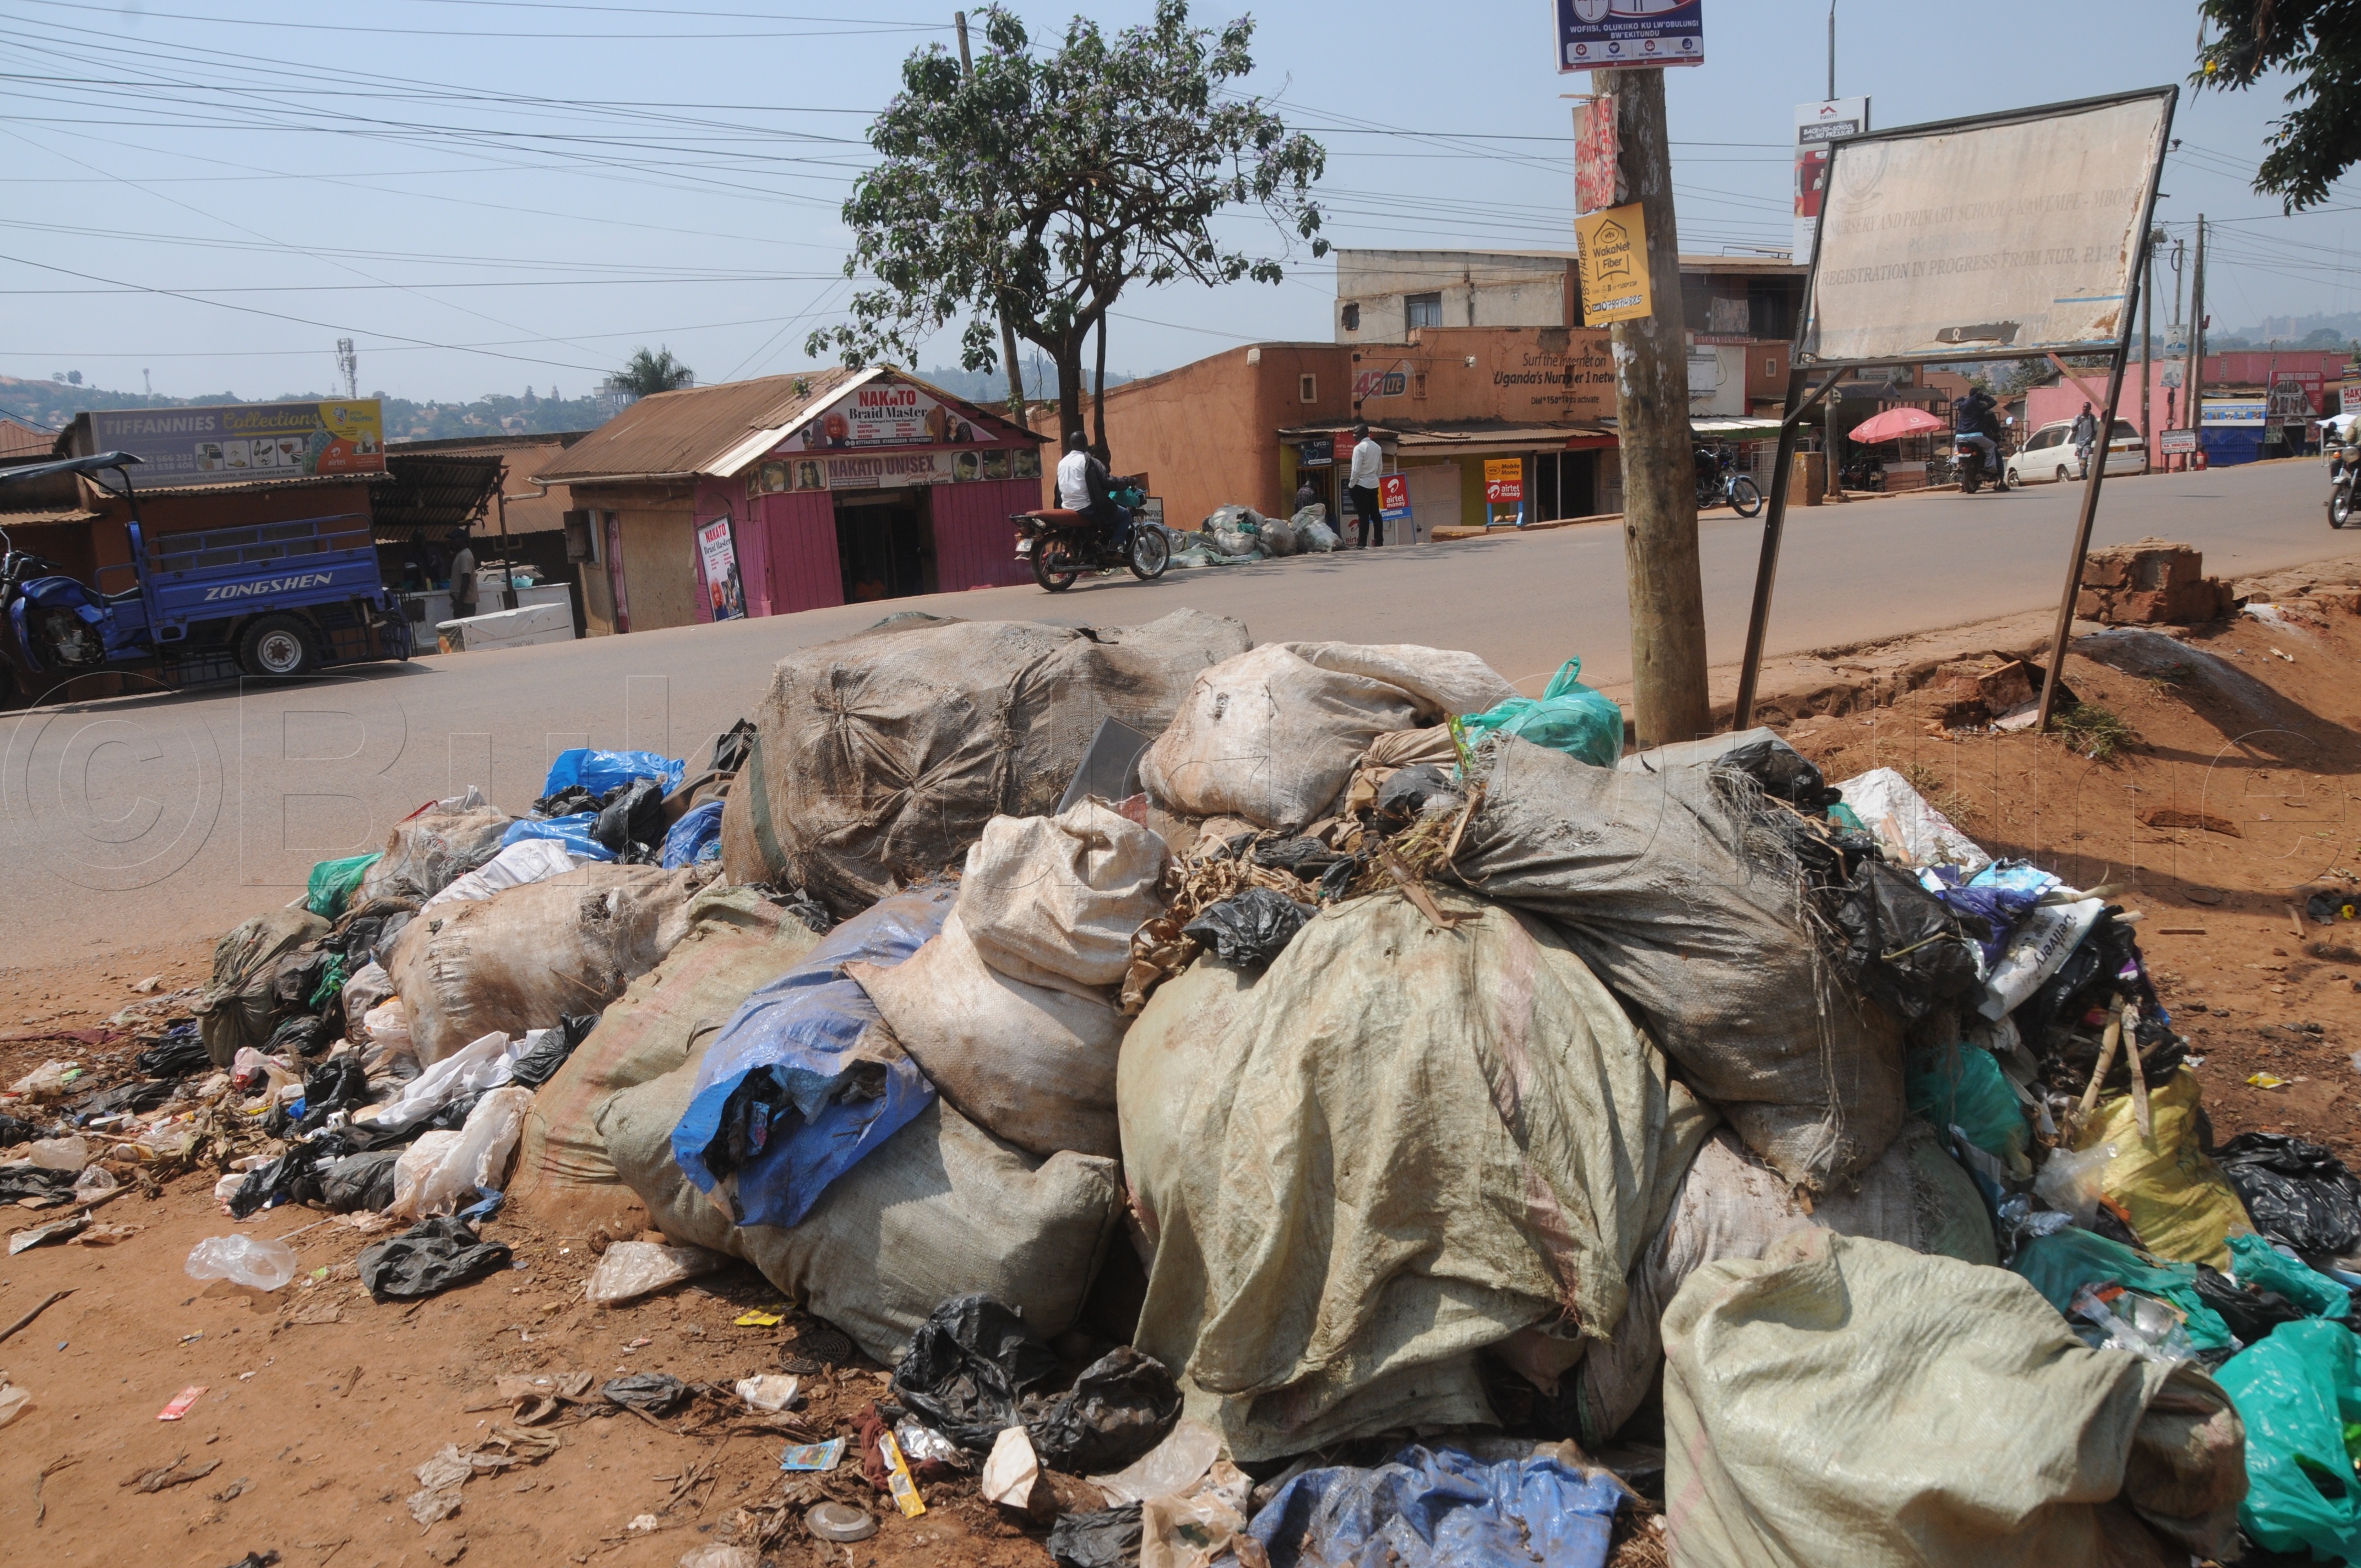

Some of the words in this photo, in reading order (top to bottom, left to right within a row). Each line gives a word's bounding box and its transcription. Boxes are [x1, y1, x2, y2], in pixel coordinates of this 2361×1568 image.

[1603, 23, 1639, 31] OLUKIIKO
[1653, 20, 1699, 28] LW'OBULUNGI
[1611, 30, 1660, 39] BW'EKITUNDU
[1828, 214, 1879, 238] NURSERY
[1877, 213, 1901, 231] AND
[1902, 206, 1955, 227] PRIMARY
[1957, 199, 2006, 222] SCHOOL
[2016, 192, 2082, 215] KAWEMPE
[1593, 240, 1630, 258] WakaNet
[1603, 257, 1623, 269] Fiber
[1820, 262, 1910, 287] REGISTRATION
[1912, 261, 1927, 277] IN
[1928, 254, 1998, 275] PROGRESS
[2001, 249, 2043, 269] FROM
[1522, 352, 1542, 367] Surf
[1543, 353, 1557, 367] the
[1595, 358, 1606, 367] on
[1385, 377, 1402, 393] LTE
[1493, 371, 1543, 388] Uganda's
[1585, 371, 1591, 384] 1
[1592, 371, 1615, 384] netw
[859, 390, 916, 407] NAKATO
[1577, 395, 1600, 404] activate
[849, 406, 883, 420] Braid
[885, 406, 928, 420] Master
[104, 416, 216, 435] TIFFANNIES
[222, 411, 322, 429] Collections
[176, 453, 193, 461] 232
[328, 458, 346, 466] airtel
[828, 458, 882, 477] NAKATO
[884, 455, 936, 475] UNISEX
[931, 469, 951, 480] Salon
[1501, 484, 1520, 492] airtel
[1386, 494, 1404, 503] airtel
[1381, 509, 1403, 518] CHARGING
[705, 523, 726, 543] NAKATO
[204, 572, 333, 601] ZONGSHEN
